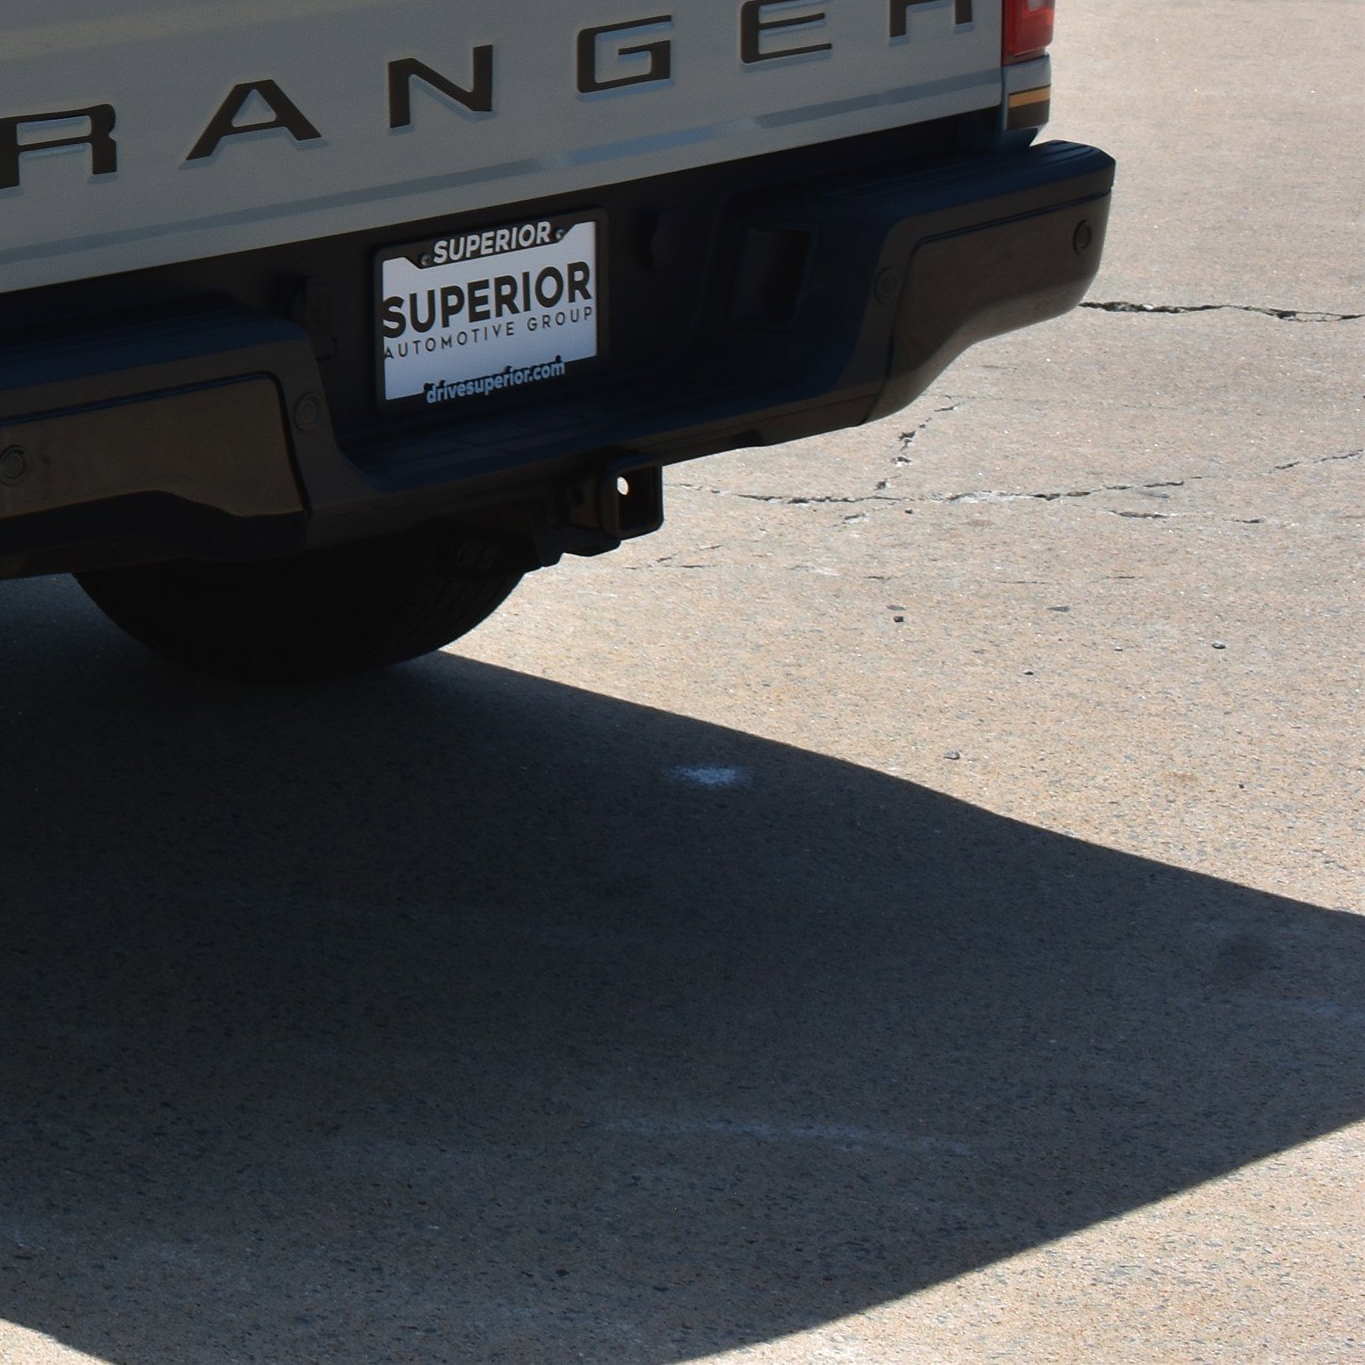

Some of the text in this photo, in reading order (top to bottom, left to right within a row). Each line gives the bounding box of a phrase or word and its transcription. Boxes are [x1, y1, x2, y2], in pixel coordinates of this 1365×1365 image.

[432, 221, 552, 264] SUPERIOR
[381, 261, 592, 338] SUPERIOR
[382, 306, 593, 360] AUTOMOTIVE GROUP
[426, 360, 566, 404] drivesuperior.com
